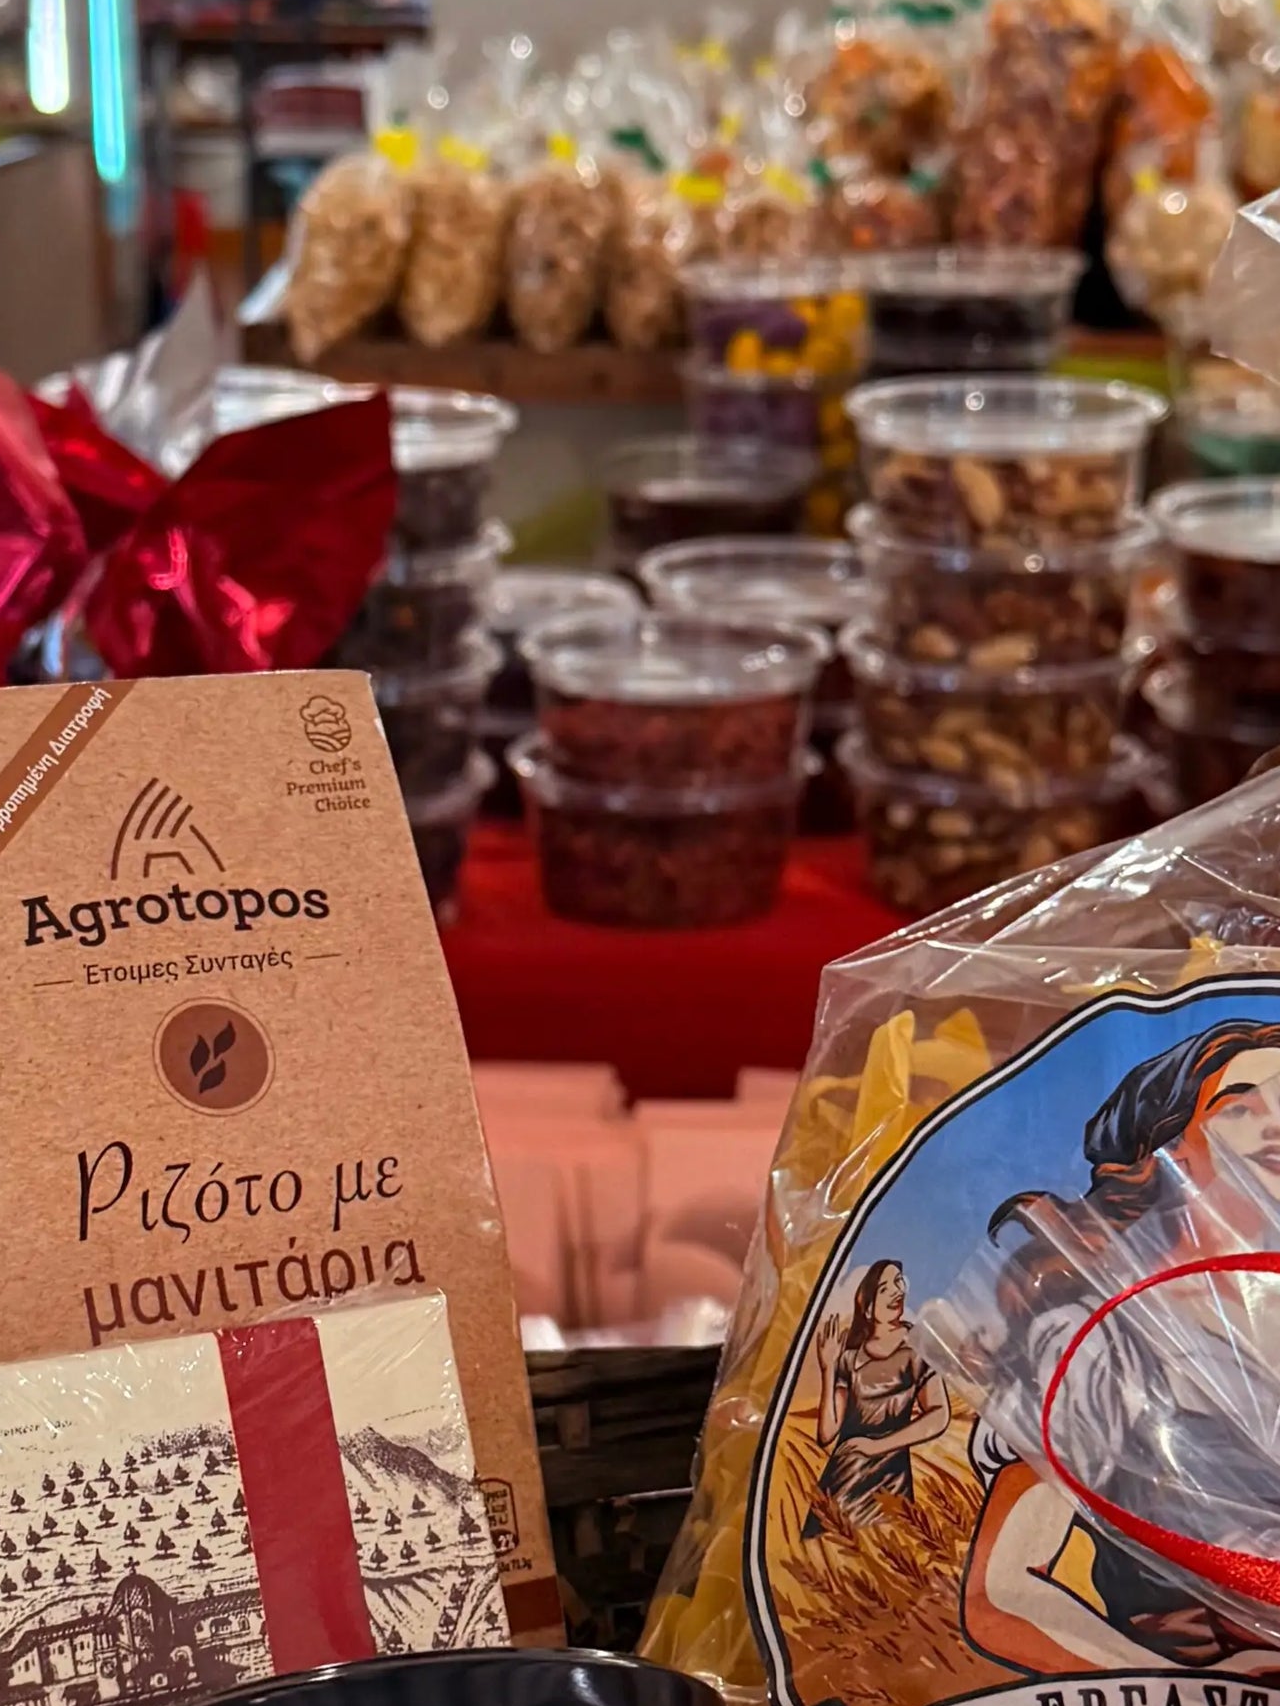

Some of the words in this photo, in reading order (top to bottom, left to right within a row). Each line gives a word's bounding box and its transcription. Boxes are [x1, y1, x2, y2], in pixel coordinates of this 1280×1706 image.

[48, 685, 113, 757] Διατροφή
[285, 777, 367, 796] Premium
[309, 757, 362, 776] Chef's
[315, 795, 371, 813] Choice
[21, 884, 331, 947] Agrotopos
[83, 960, 179, 986] Έτοιμες
[184, 947, 294, 975] Συνταγές
[77, 1140, 303, 1244] Ριζότο
[332, 1155, 404, 1232] με
[83, 1236, 426, 1346] μανιτάρια
